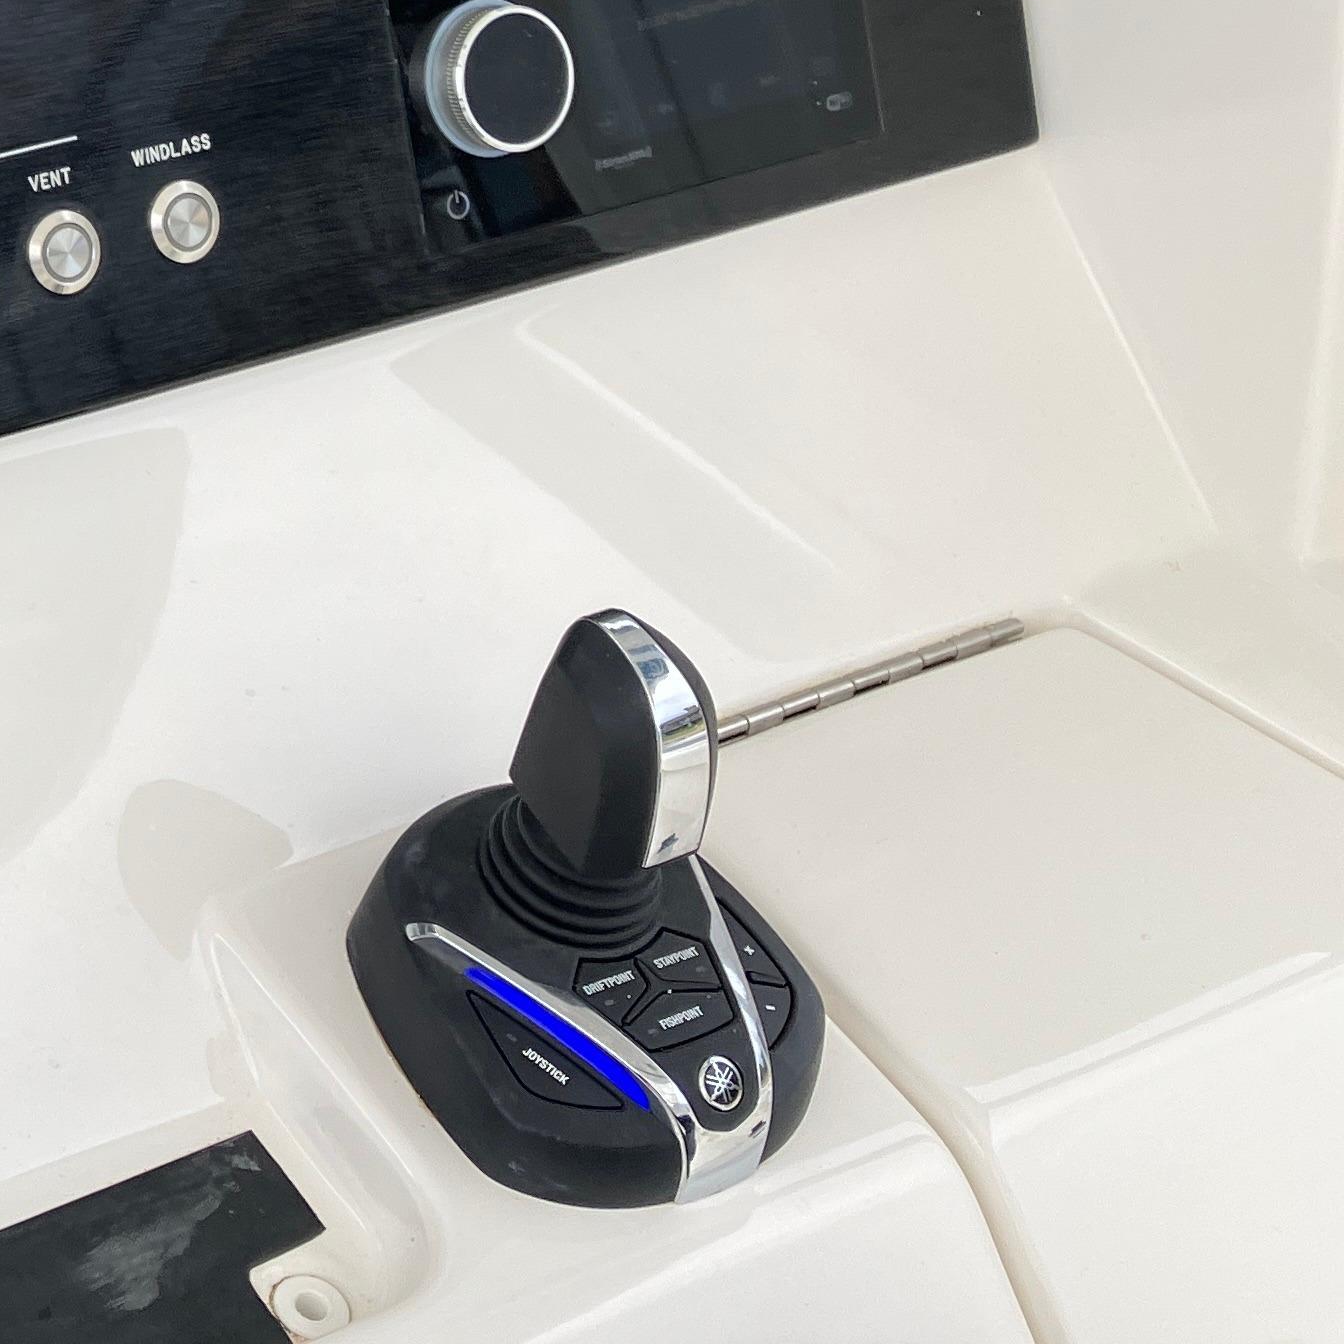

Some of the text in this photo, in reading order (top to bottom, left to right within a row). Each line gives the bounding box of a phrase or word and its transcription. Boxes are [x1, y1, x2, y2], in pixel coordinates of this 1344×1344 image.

[130, 132, 212, 168] WINDLASS
[27, 166, 72, 193] VENT
[653, 946, 700, 969] STAYPOINT
[583, 970, 635, 996] DRIFTPOINT
[659, 1005, 703, 1030] FISHPOINT
[522, 1048, 570, 1085] JOYSTICK
